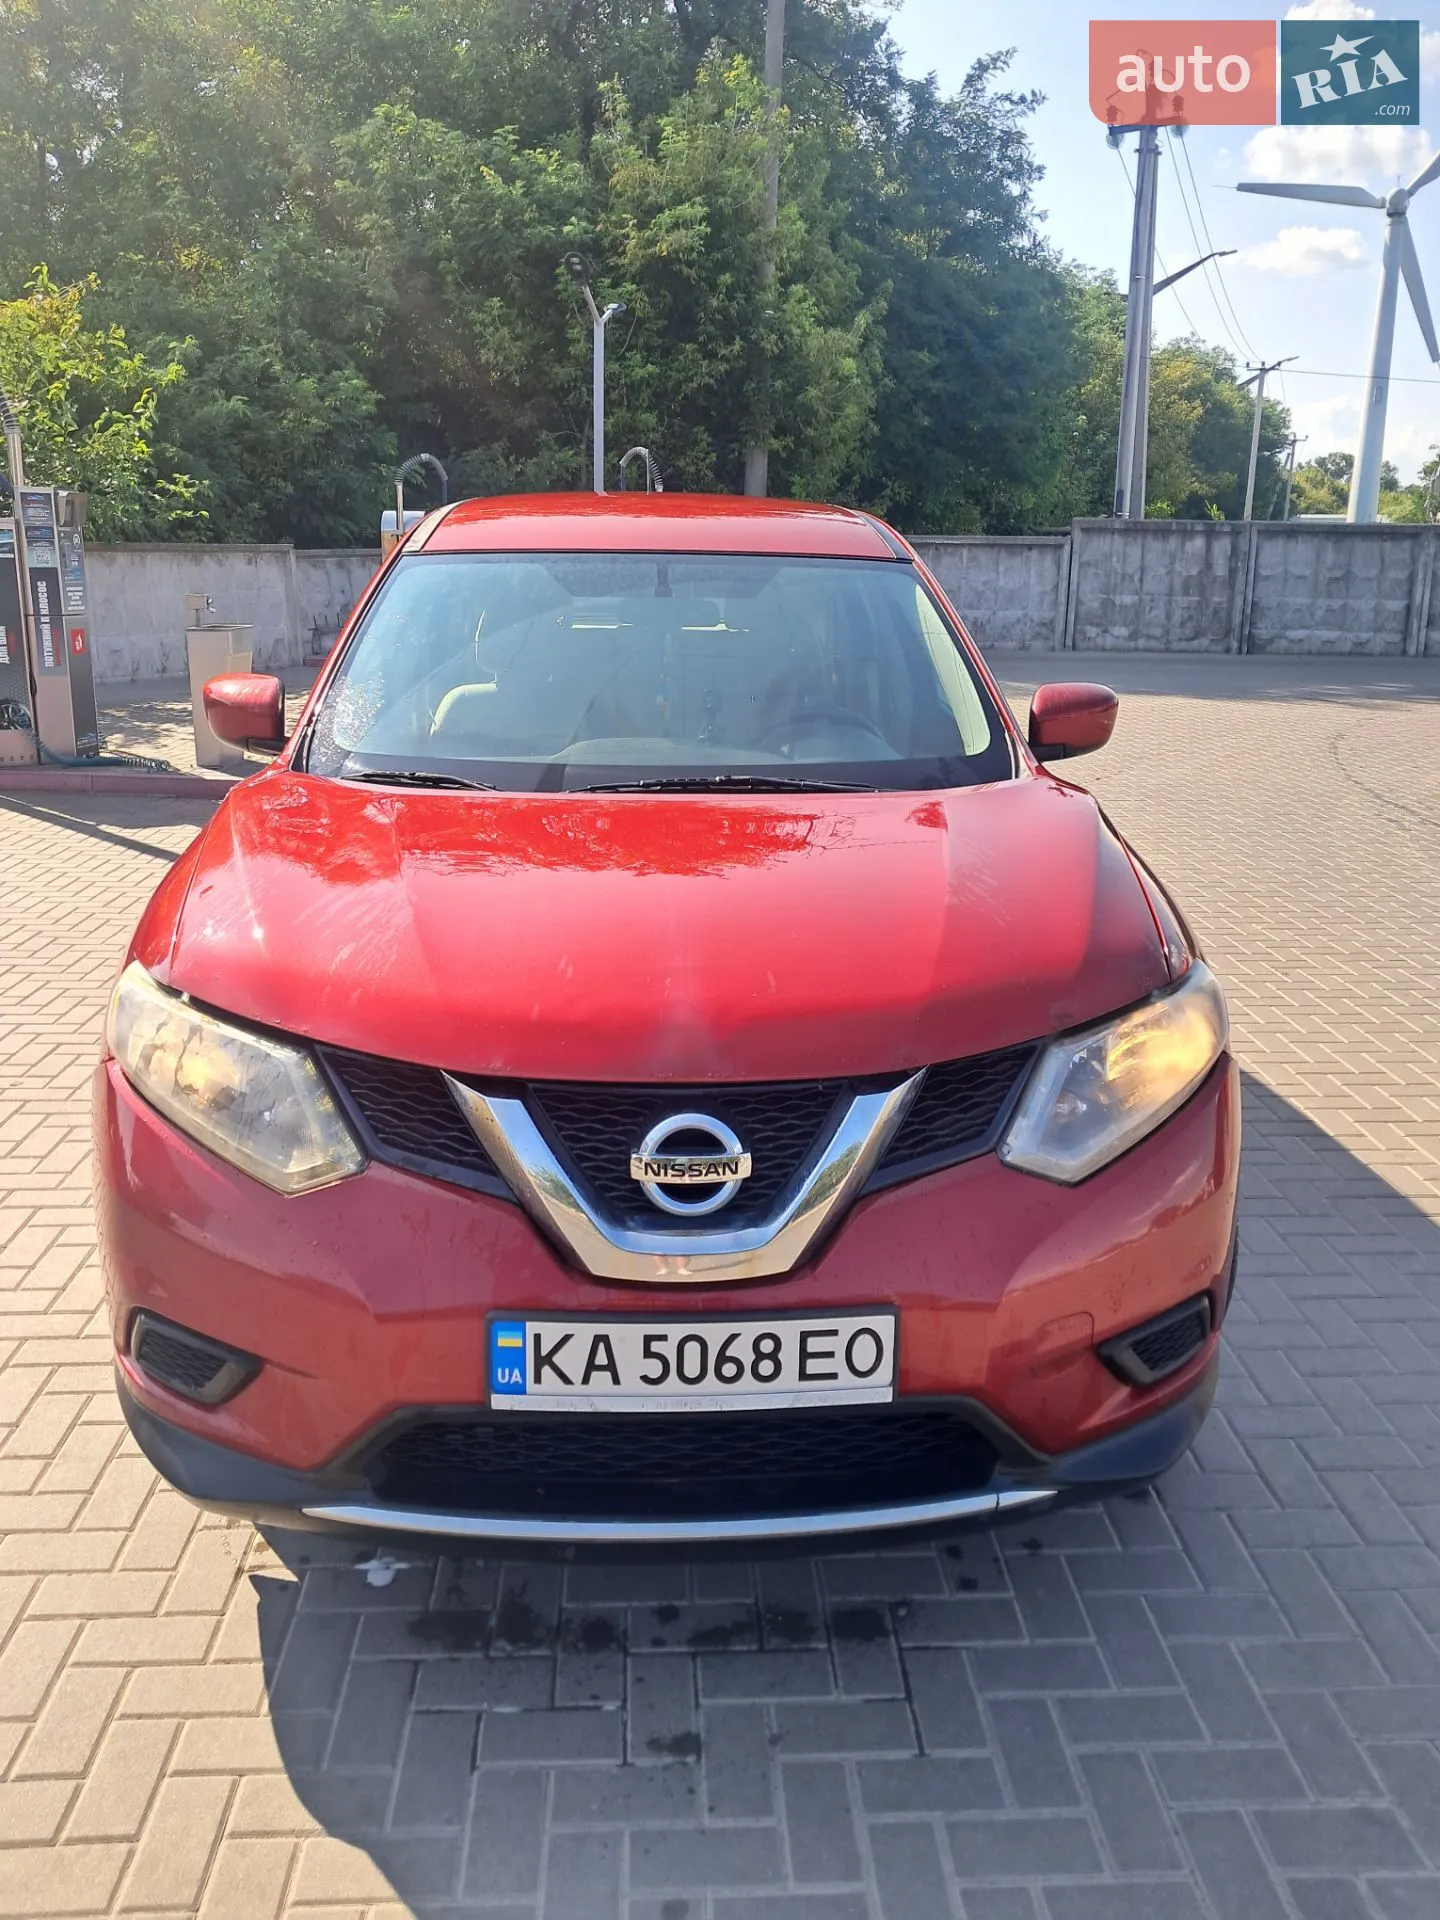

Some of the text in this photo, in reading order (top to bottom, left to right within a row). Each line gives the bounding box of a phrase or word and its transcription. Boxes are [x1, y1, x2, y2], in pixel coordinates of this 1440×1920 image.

[644, 1161, 740, 1178] NISSAN
[533, 1327, 884, 1386] KA 5068 EO
[497, 1367, 523, 1384] UA
